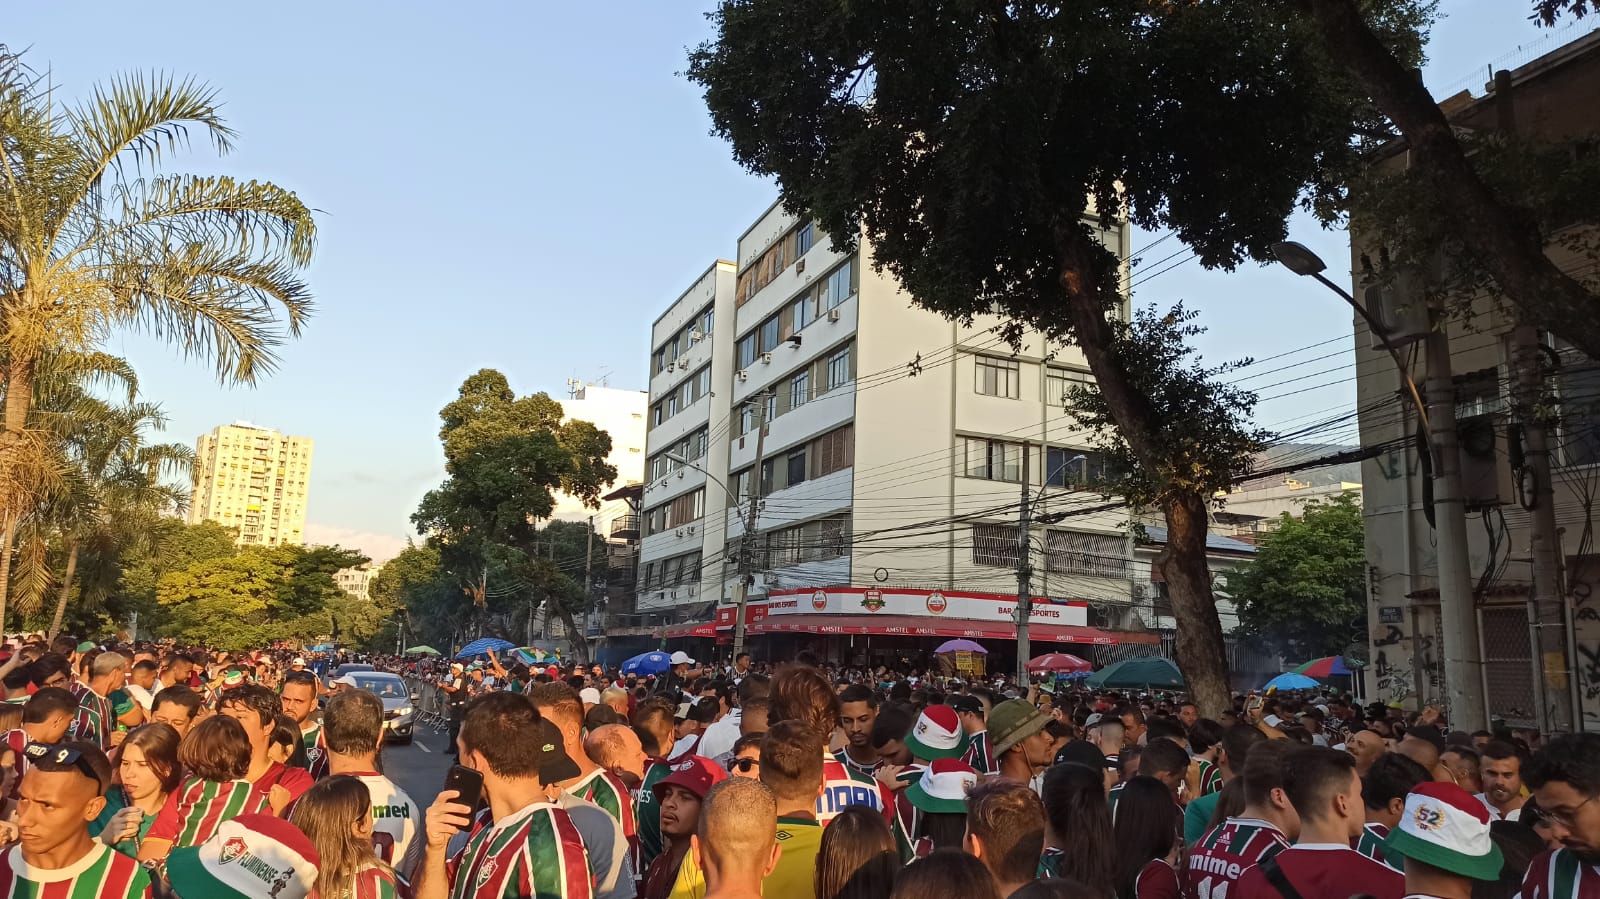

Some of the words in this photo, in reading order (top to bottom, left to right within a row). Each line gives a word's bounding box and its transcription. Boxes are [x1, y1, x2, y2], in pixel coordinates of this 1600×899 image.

[998, 606, 1012, 614] BAR
[1029, 609, 1060, 618] ESPORTES
[26, 745, 47, 756] FRED
[56, 749, 69, 763] 9
[373, 801, 410, 819] med
[1417, 806, 1440, 826] 52
[237, 851, 279, 884] FLUMINENSE
[1190, 850, 1240, 880] nime
